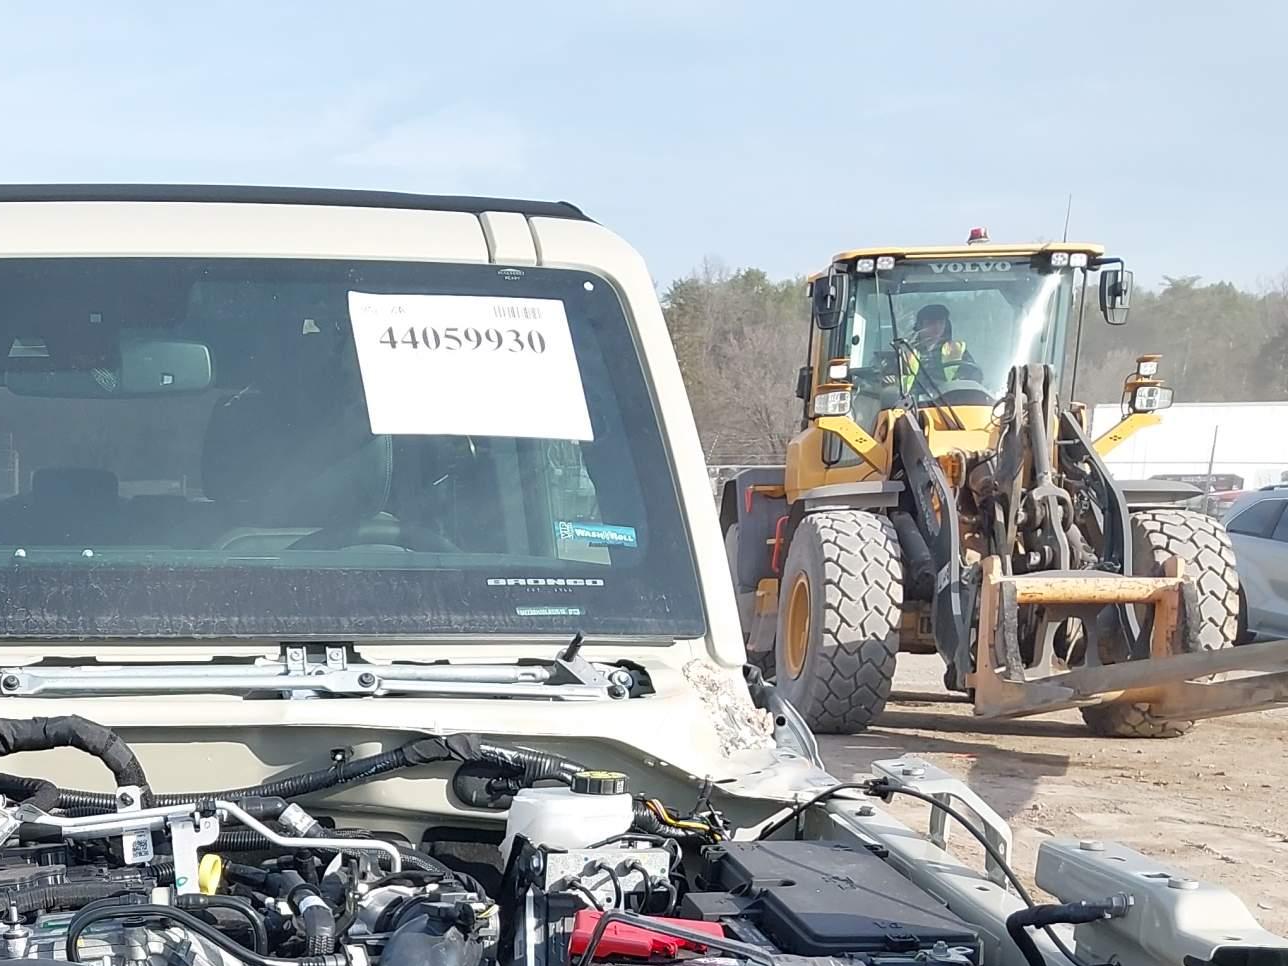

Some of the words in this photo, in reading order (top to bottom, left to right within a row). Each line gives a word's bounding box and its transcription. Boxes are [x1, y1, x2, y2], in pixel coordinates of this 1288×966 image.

[929, 261, 1012, 274] VOLVO
[379, 325, 546, 354] 44059930
[487, 578, 605, 586] BRONCO
